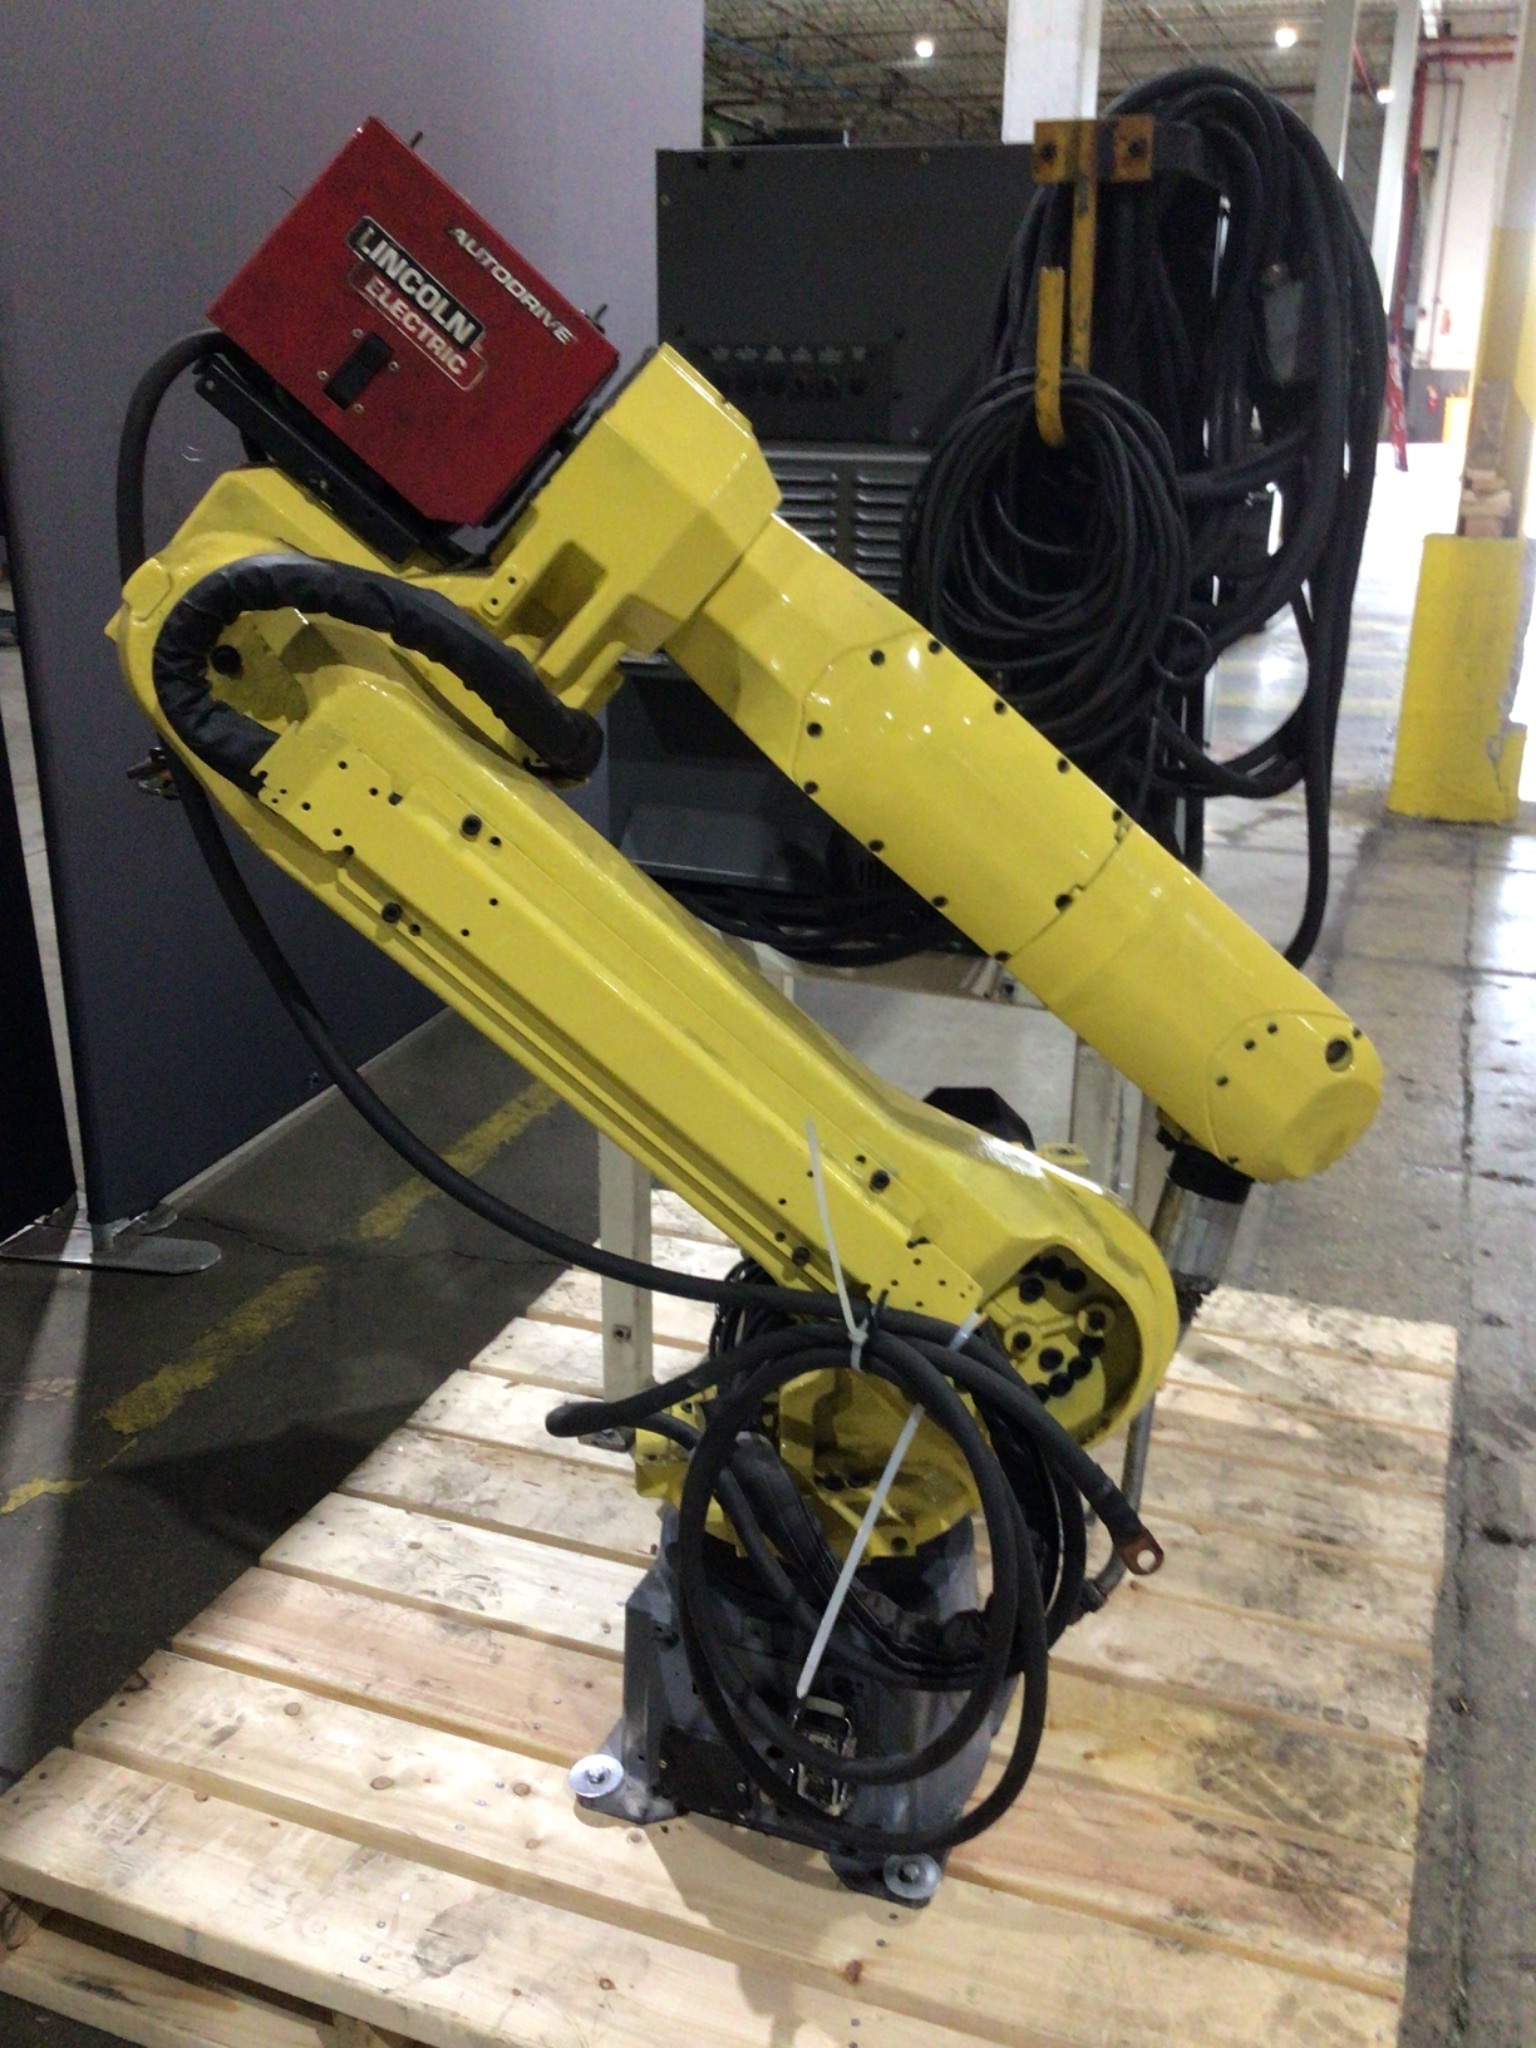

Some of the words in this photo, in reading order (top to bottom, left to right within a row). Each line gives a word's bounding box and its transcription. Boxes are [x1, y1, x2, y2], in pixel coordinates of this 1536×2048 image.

[357, 226, 477, 344] LINCOLN
[364, 275, 468, 375] ELECTRIC
[449, 228, 576, 345] AUTODRIVE
